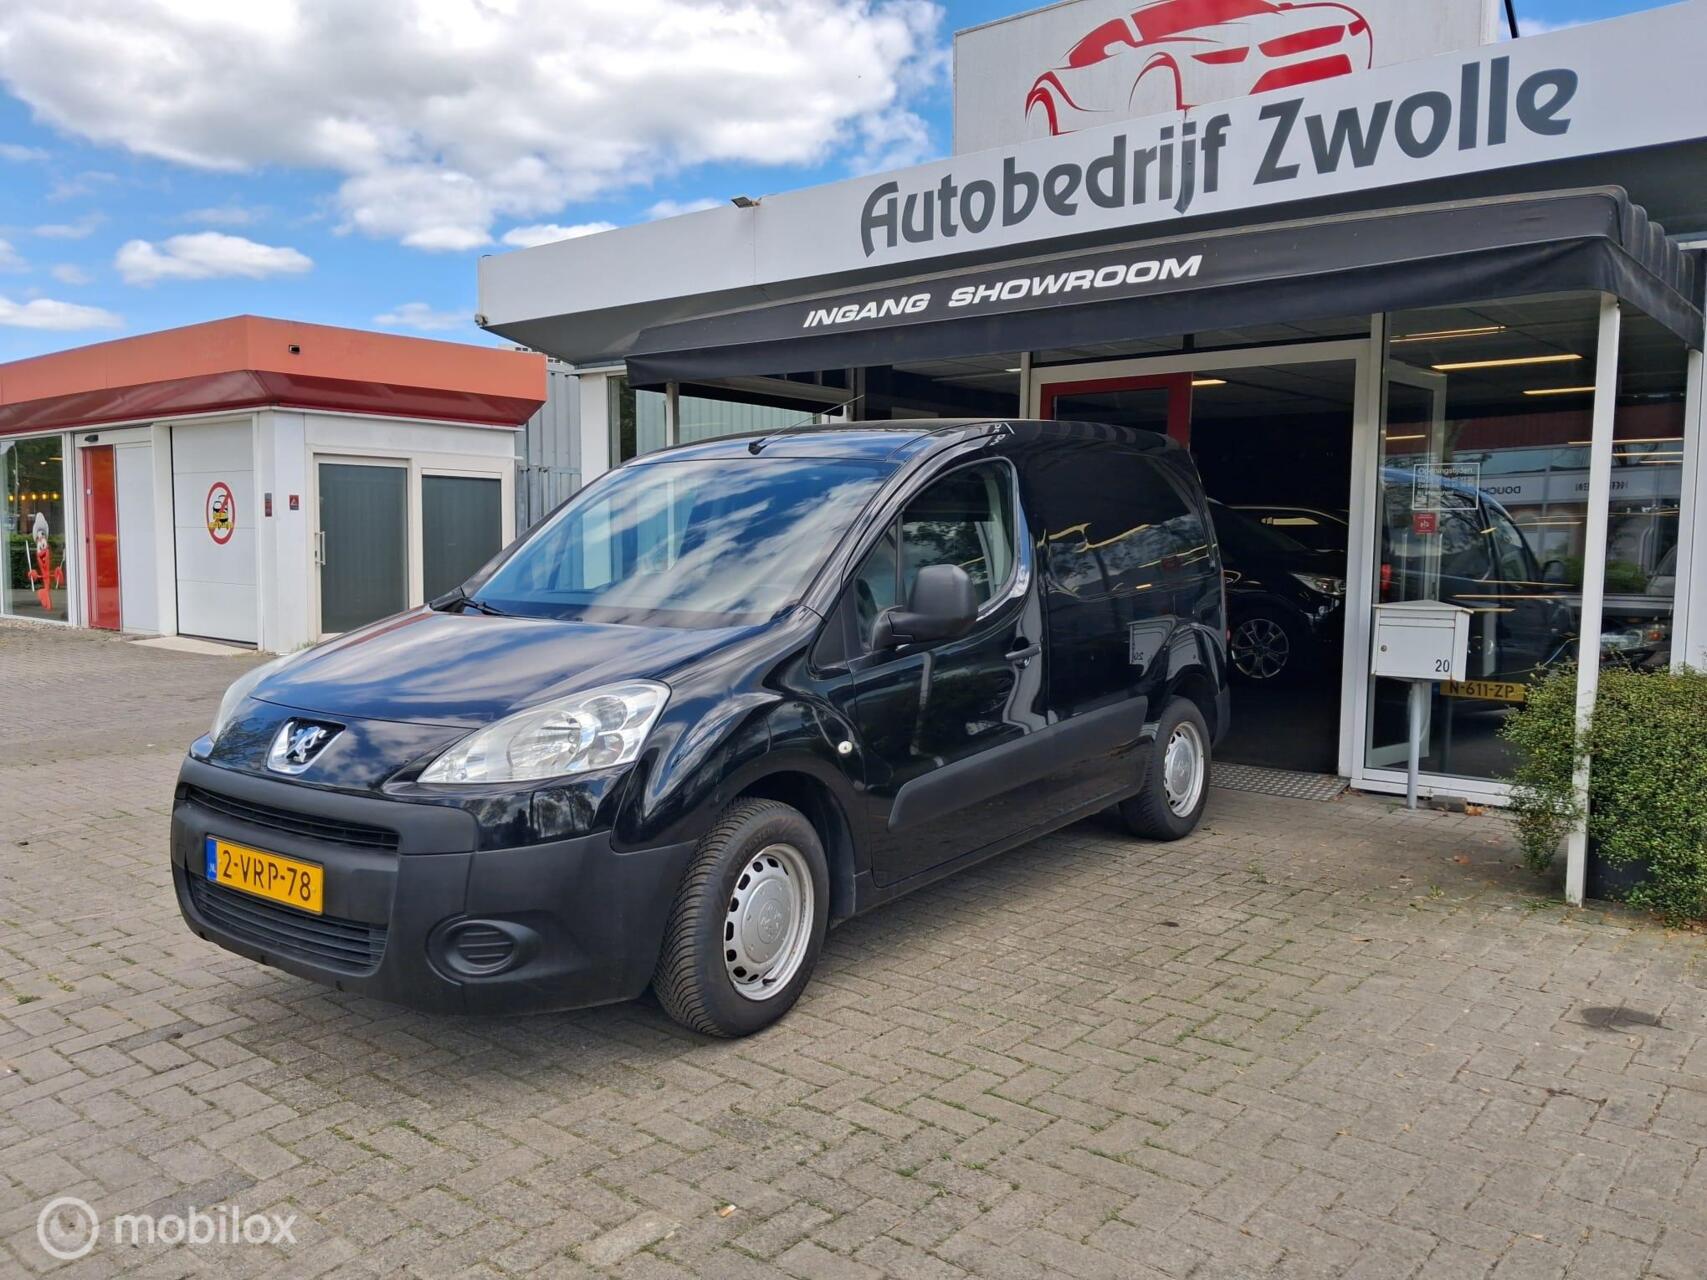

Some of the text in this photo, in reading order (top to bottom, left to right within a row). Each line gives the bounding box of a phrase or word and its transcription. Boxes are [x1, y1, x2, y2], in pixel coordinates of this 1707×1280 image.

[860, 55, 1578, 258] Autobedrijf Zwolle
[803, 254, 1203, 328] INGANG SHOWROOM
[1435, 659, 1450, 672] 20
[1449, 682, 1514, 698] N-611-ZP
[222, 849, 311, 901] 2-VRP-78
